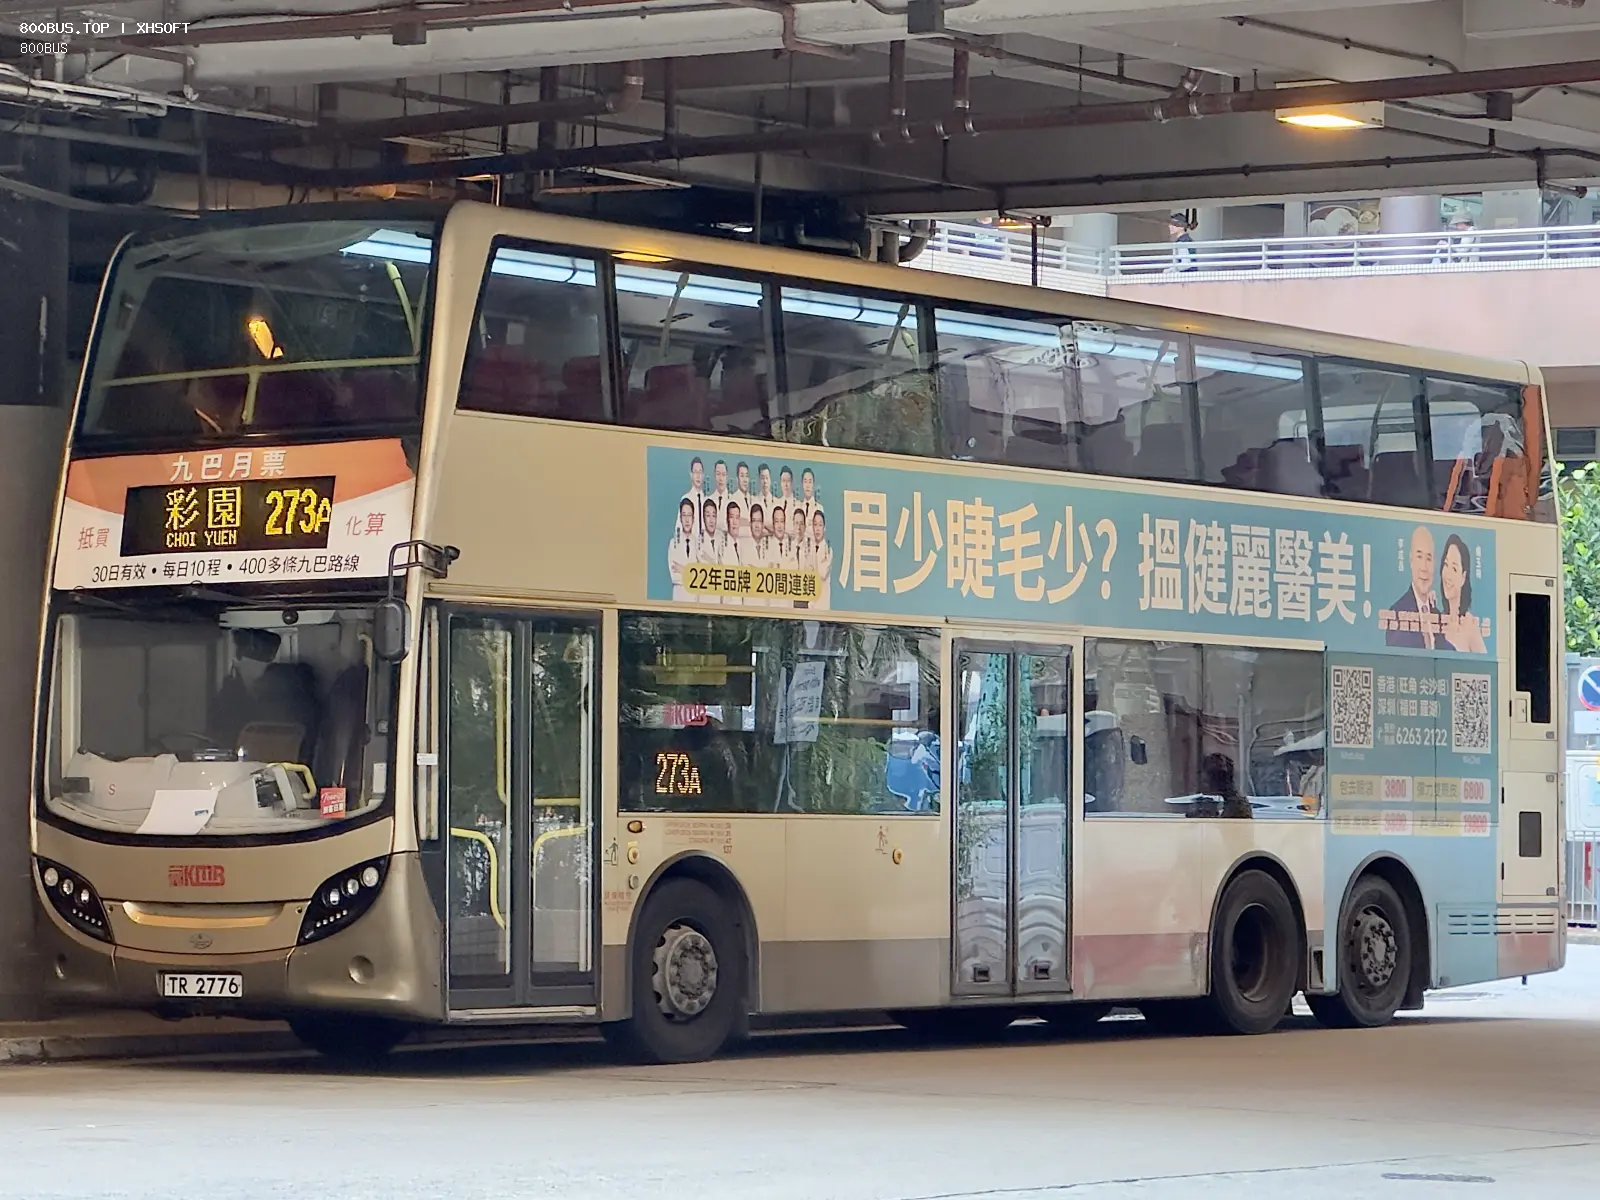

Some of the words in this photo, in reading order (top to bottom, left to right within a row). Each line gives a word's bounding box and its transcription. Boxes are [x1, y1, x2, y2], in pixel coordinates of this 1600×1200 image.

[169, 450, 287, 482] 九巴月票
[165, 486, 242, 531] 彩園
[265, 488, 332, 535] 273A
[77, 527, 110, 551] 抵買
[166, 532, 196, 548] CHOI
[204, 529, 237, 546] YUEN
[345, 512, 387, 537] 化算
[92, 563, 147, 583] 30日有效
[162, 558, 221, 579] 每日10程
[239, 554, 360, 577] 400多條九巴路線
[840, 489, 1118, 604] 眉少睫毛少?
[1138, 512, 1372, 625] 搵健麗醫美!
[689, 567, 751, 592] 22年品牌
[756, 572, 817, 597] 20間連鎖
[1396, 727, 1421, 746] 6263
[1423, 728, 1448, 747] 2122
[655, 753, 702, 794] 273A
[168, 977, 188, 995] TR
[195, 976, 239, 995] 2776
